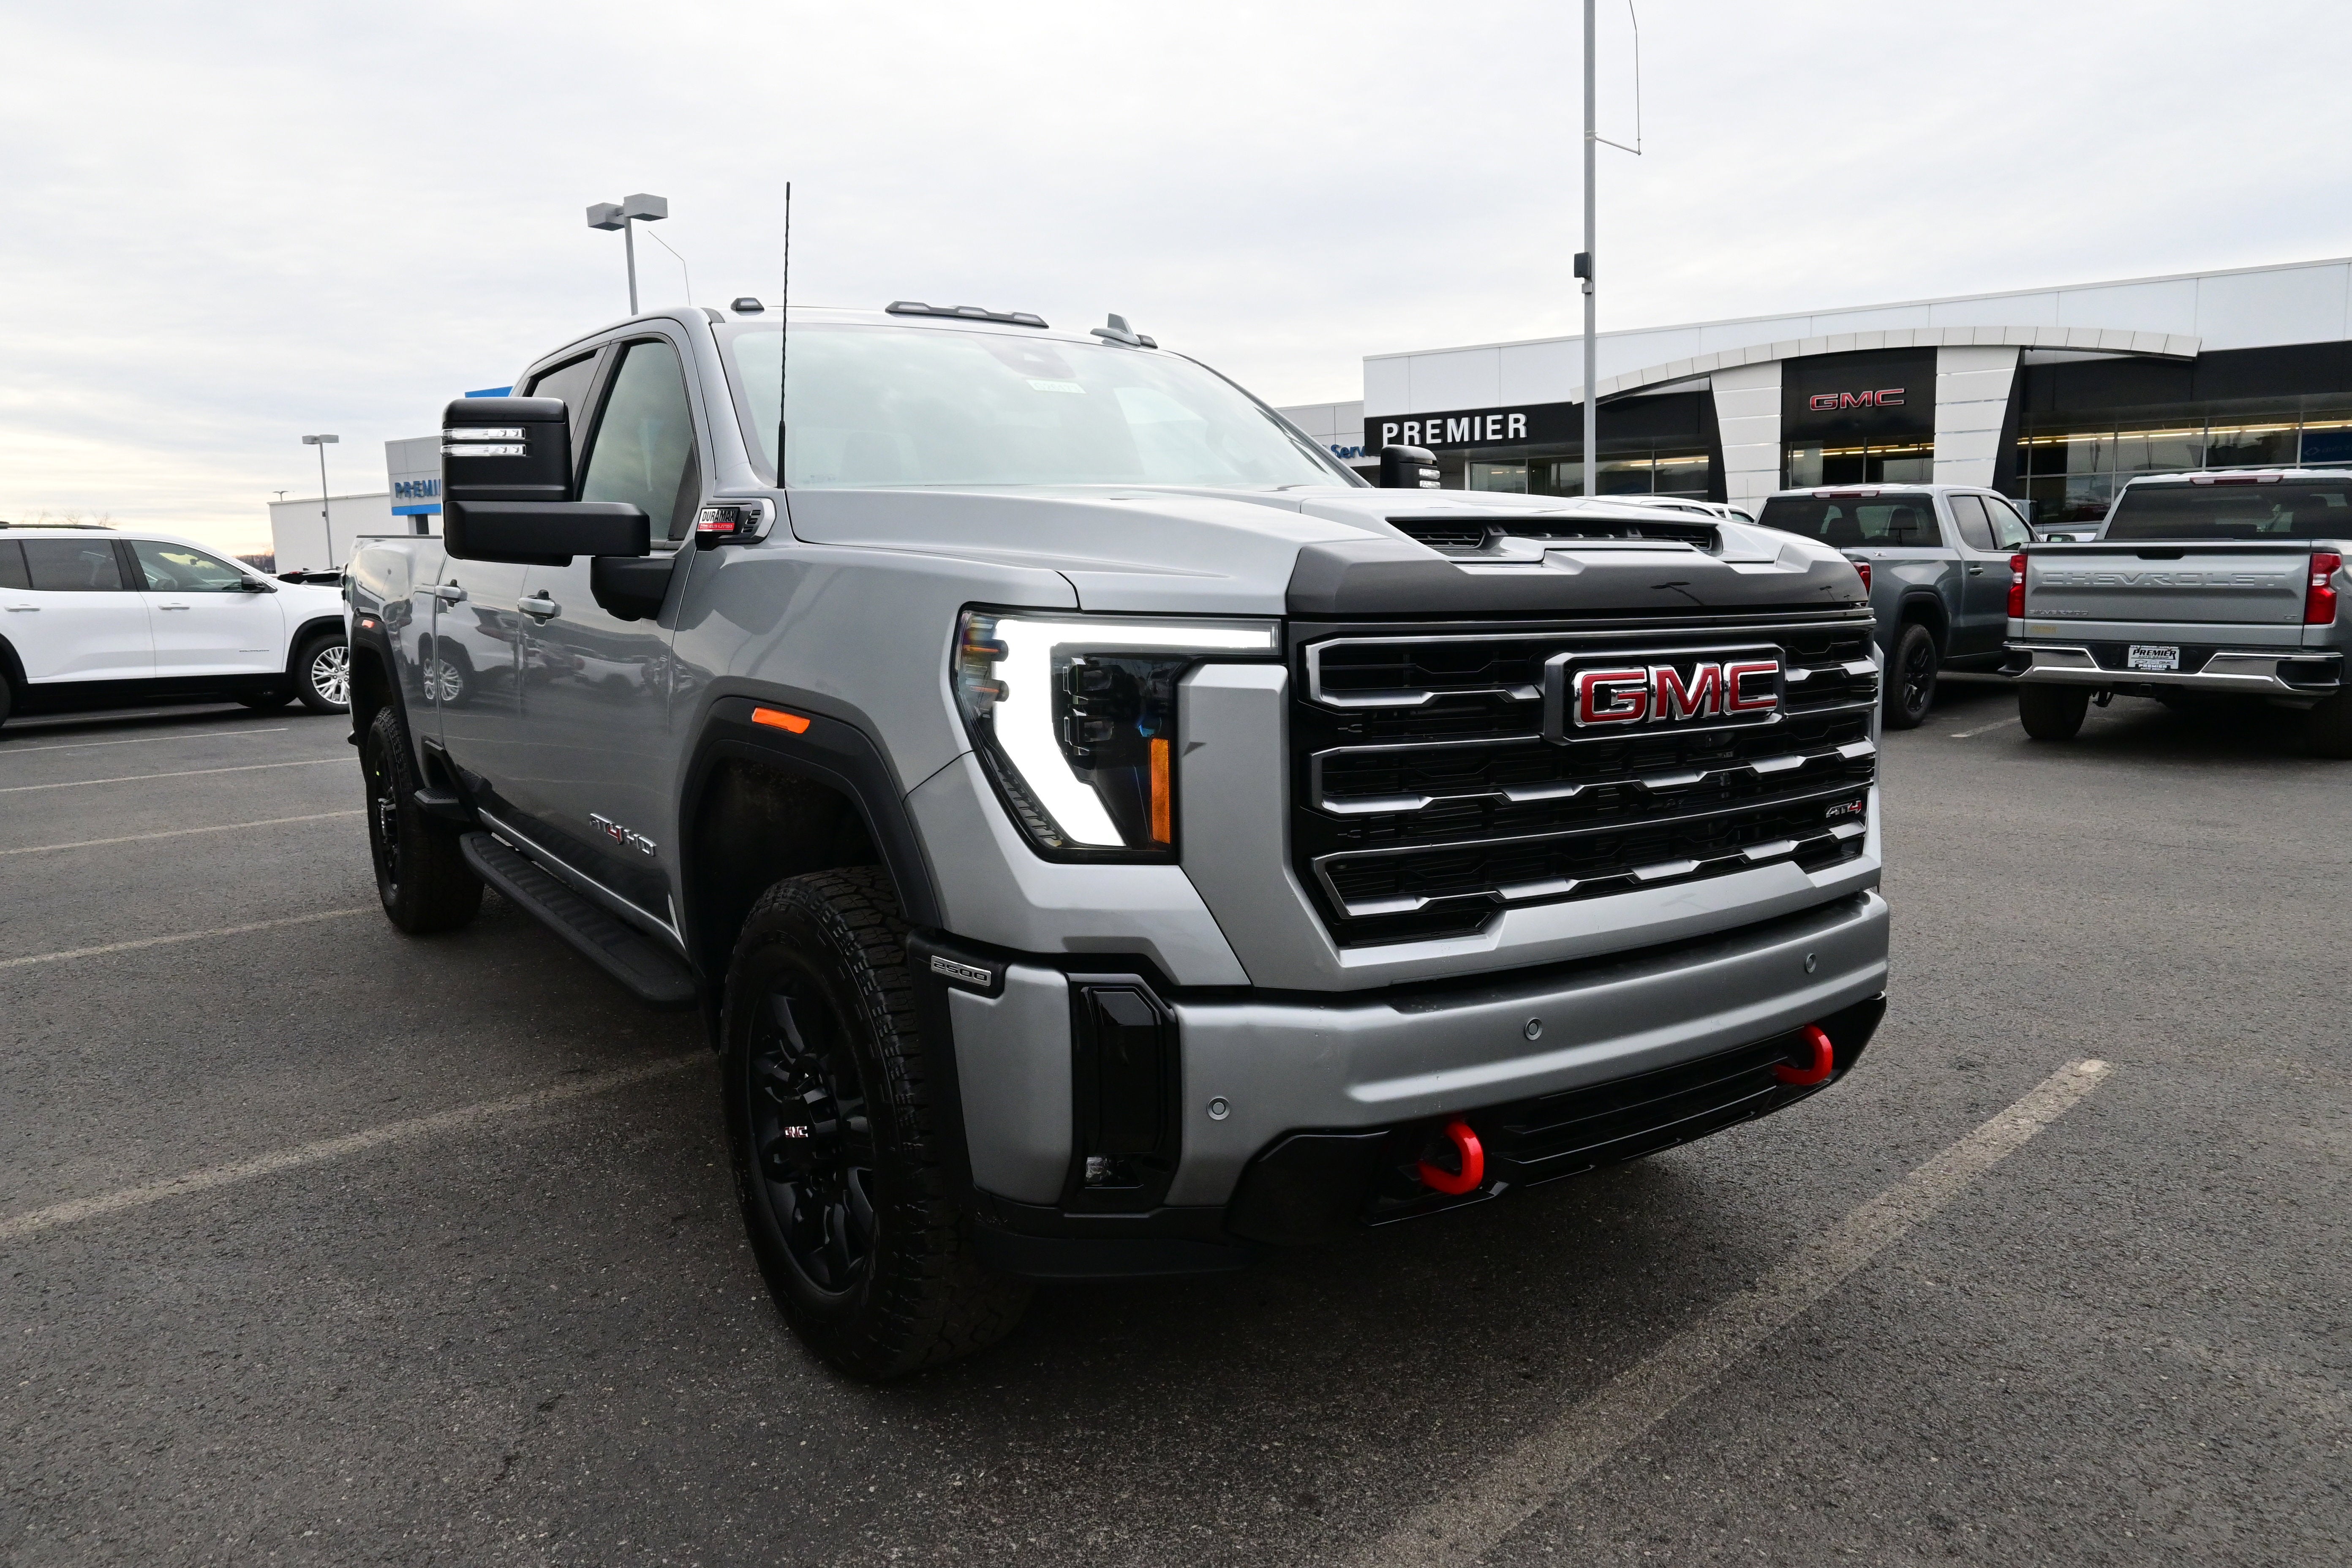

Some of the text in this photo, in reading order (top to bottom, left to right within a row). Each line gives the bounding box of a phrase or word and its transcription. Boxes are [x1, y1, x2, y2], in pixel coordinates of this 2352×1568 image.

[1810, 388, 1905, 411] GMC
[1382, 413, 1527, 446] PREMIER
[395, 479, 441, 498] PREMI
[702, 510, 736, 522] DURAMAX
[2042, 572, 2286, 586] CHEVROLET
[2133, 649, 2176, 660] PREMIER
[1573, 660, 1779, 727] GMC
[1826, 800, 1862, 818] AT4
[933, 961, 987, 982] 2500
[784, 1126, 808, 1138] GMC
